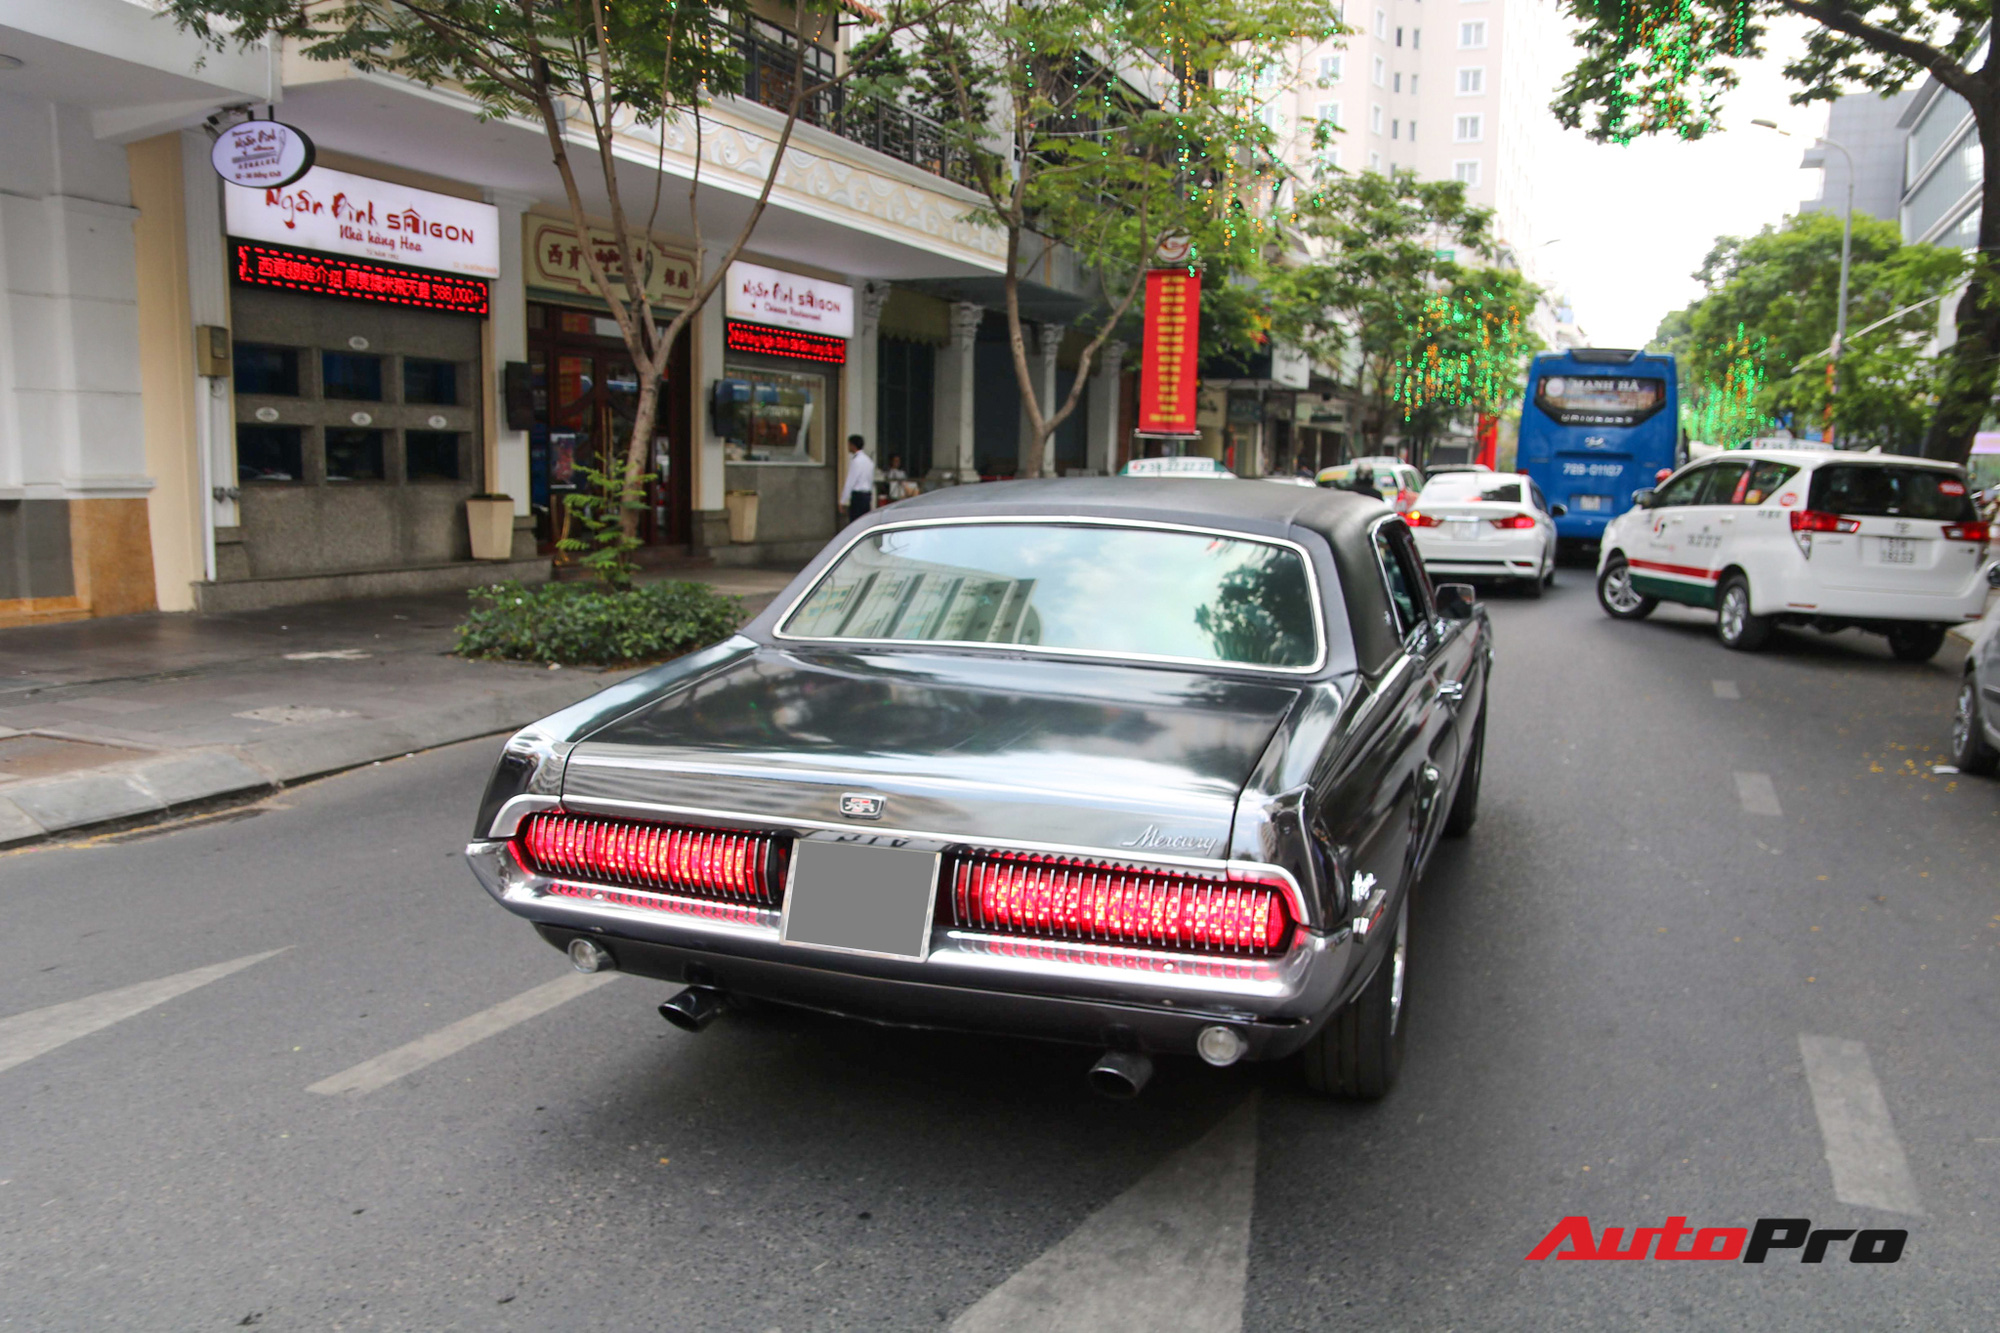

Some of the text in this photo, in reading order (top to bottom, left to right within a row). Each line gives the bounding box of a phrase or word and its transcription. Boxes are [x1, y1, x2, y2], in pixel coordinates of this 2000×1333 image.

[331, 192, 377, 226] Đình
[340, 225, 423, 252] Nhà hàng Hoa
[1121, 824, 1218, 856] Mercury
